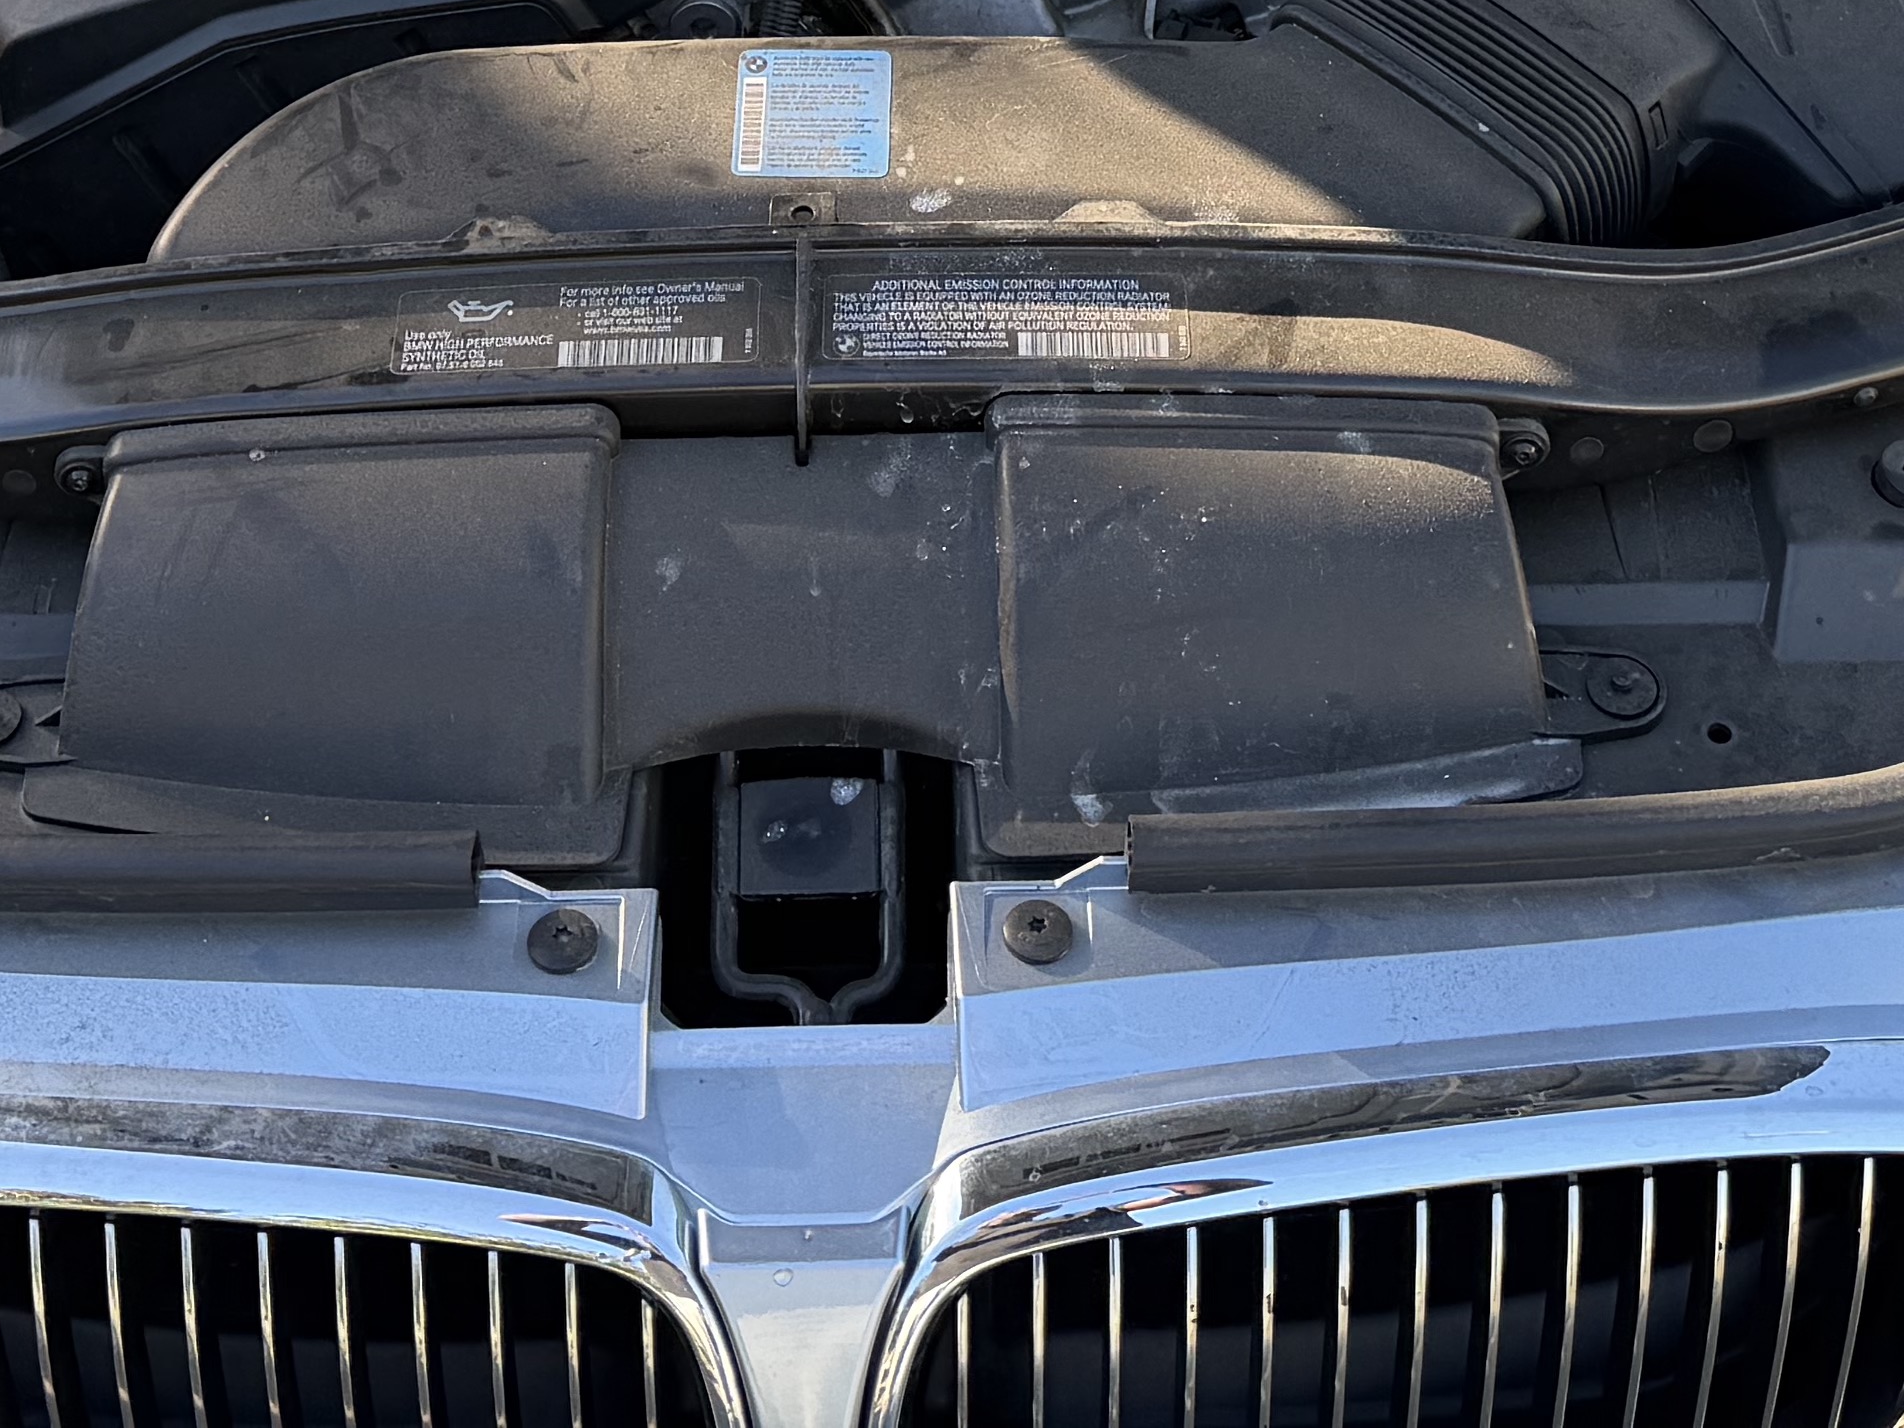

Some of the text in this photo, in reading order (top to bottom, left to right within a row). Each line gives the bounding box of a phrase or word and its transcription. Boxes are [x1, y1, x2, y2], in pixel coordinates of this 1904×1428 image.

[705, 281, 745, 292] Manual
[871, 278, 1139, 291] ADDITIONAL EMISSION CONTROL INFORMATION
[559, 297, 577, 307] For
[653, 293, 705, 305] approved
[1017, 291, 1053, 301] OZONE
[1055, 291, 1115, 301] REDUCTION
[1117, 291, 1170, 302] RADIATOR
[403, 340, 433, 352] BMW
[466, 333, 554, 349] PERFORMANCE
[402, 350, 467, 362] SYNTHETIC
